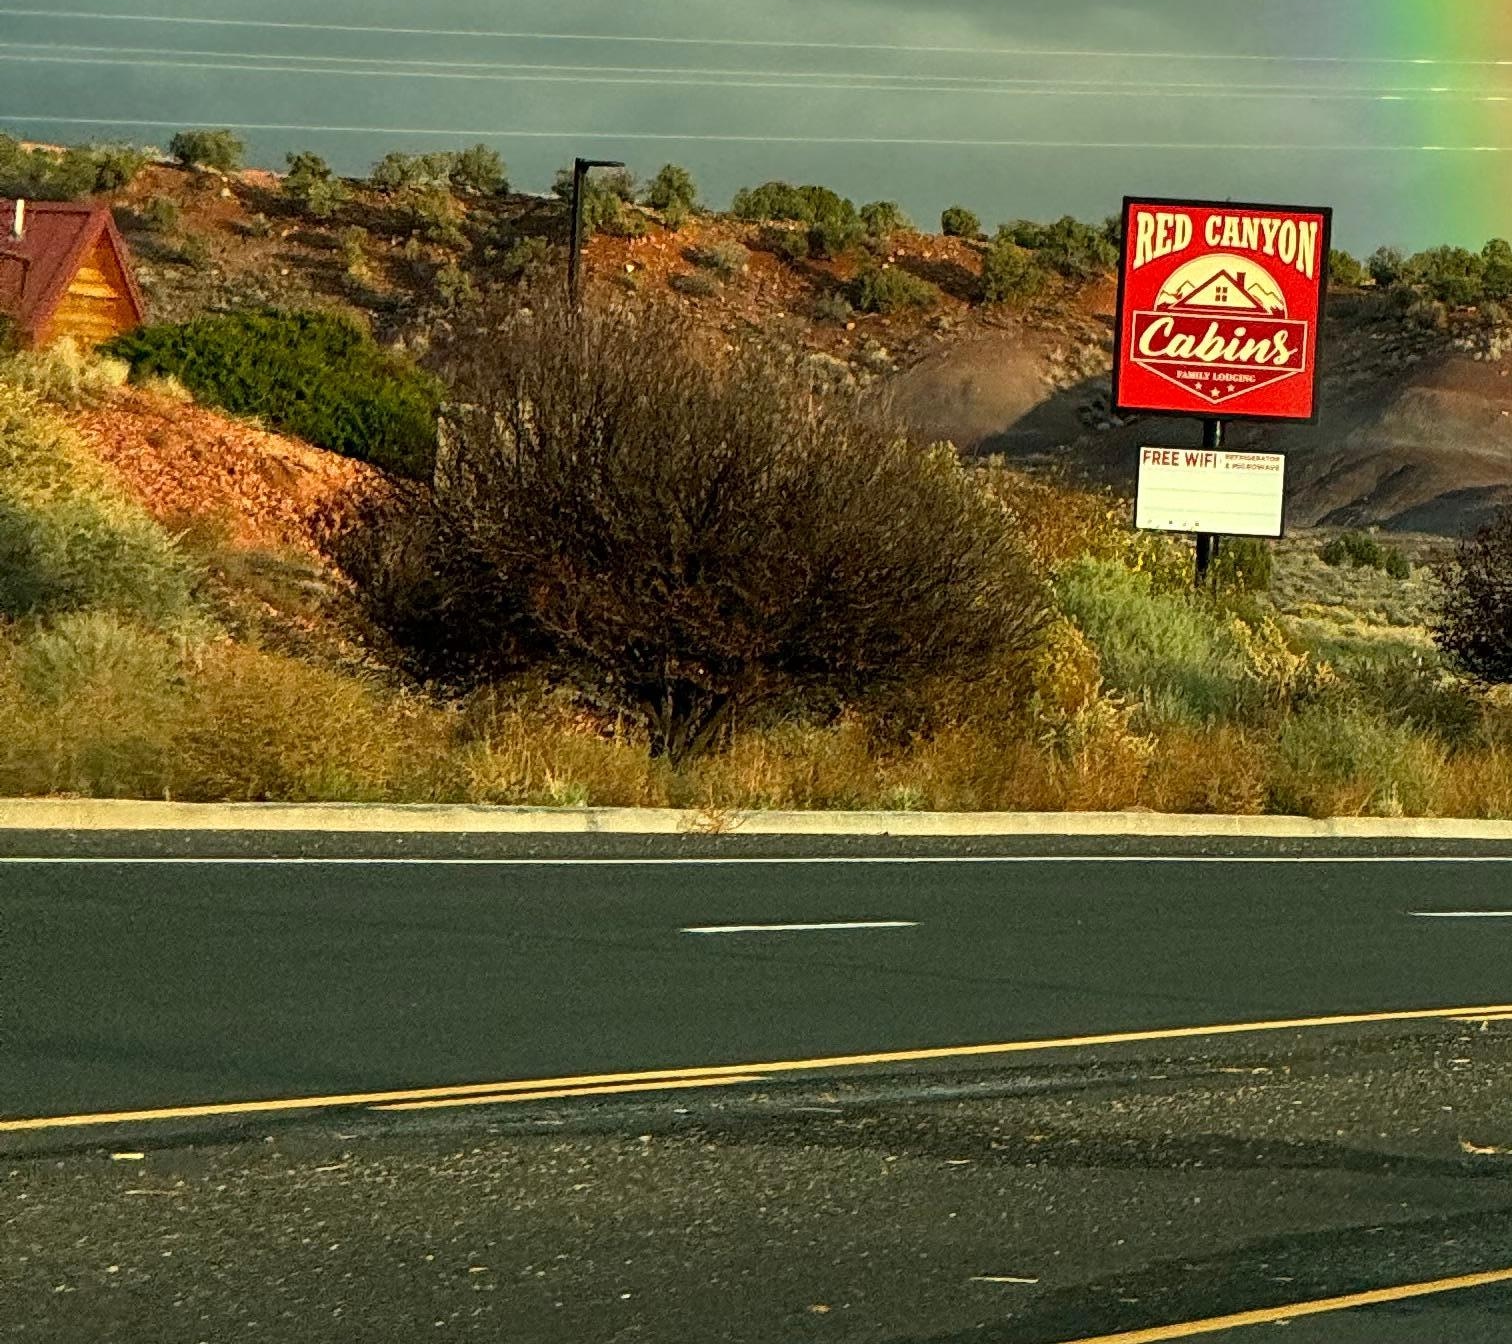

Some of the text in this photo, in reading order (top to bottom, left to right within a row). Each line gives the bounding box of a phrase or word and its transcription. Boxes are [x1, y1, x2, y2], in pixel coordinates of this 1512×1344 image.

[1133, 211, 1318, 280] RED CANYON
[1139, 315, 1298, 365] Cabins
[1176, 370, 1256, 383] FAMILY LODGING
[1143, 449, 1218, 469] FREE WIFI
